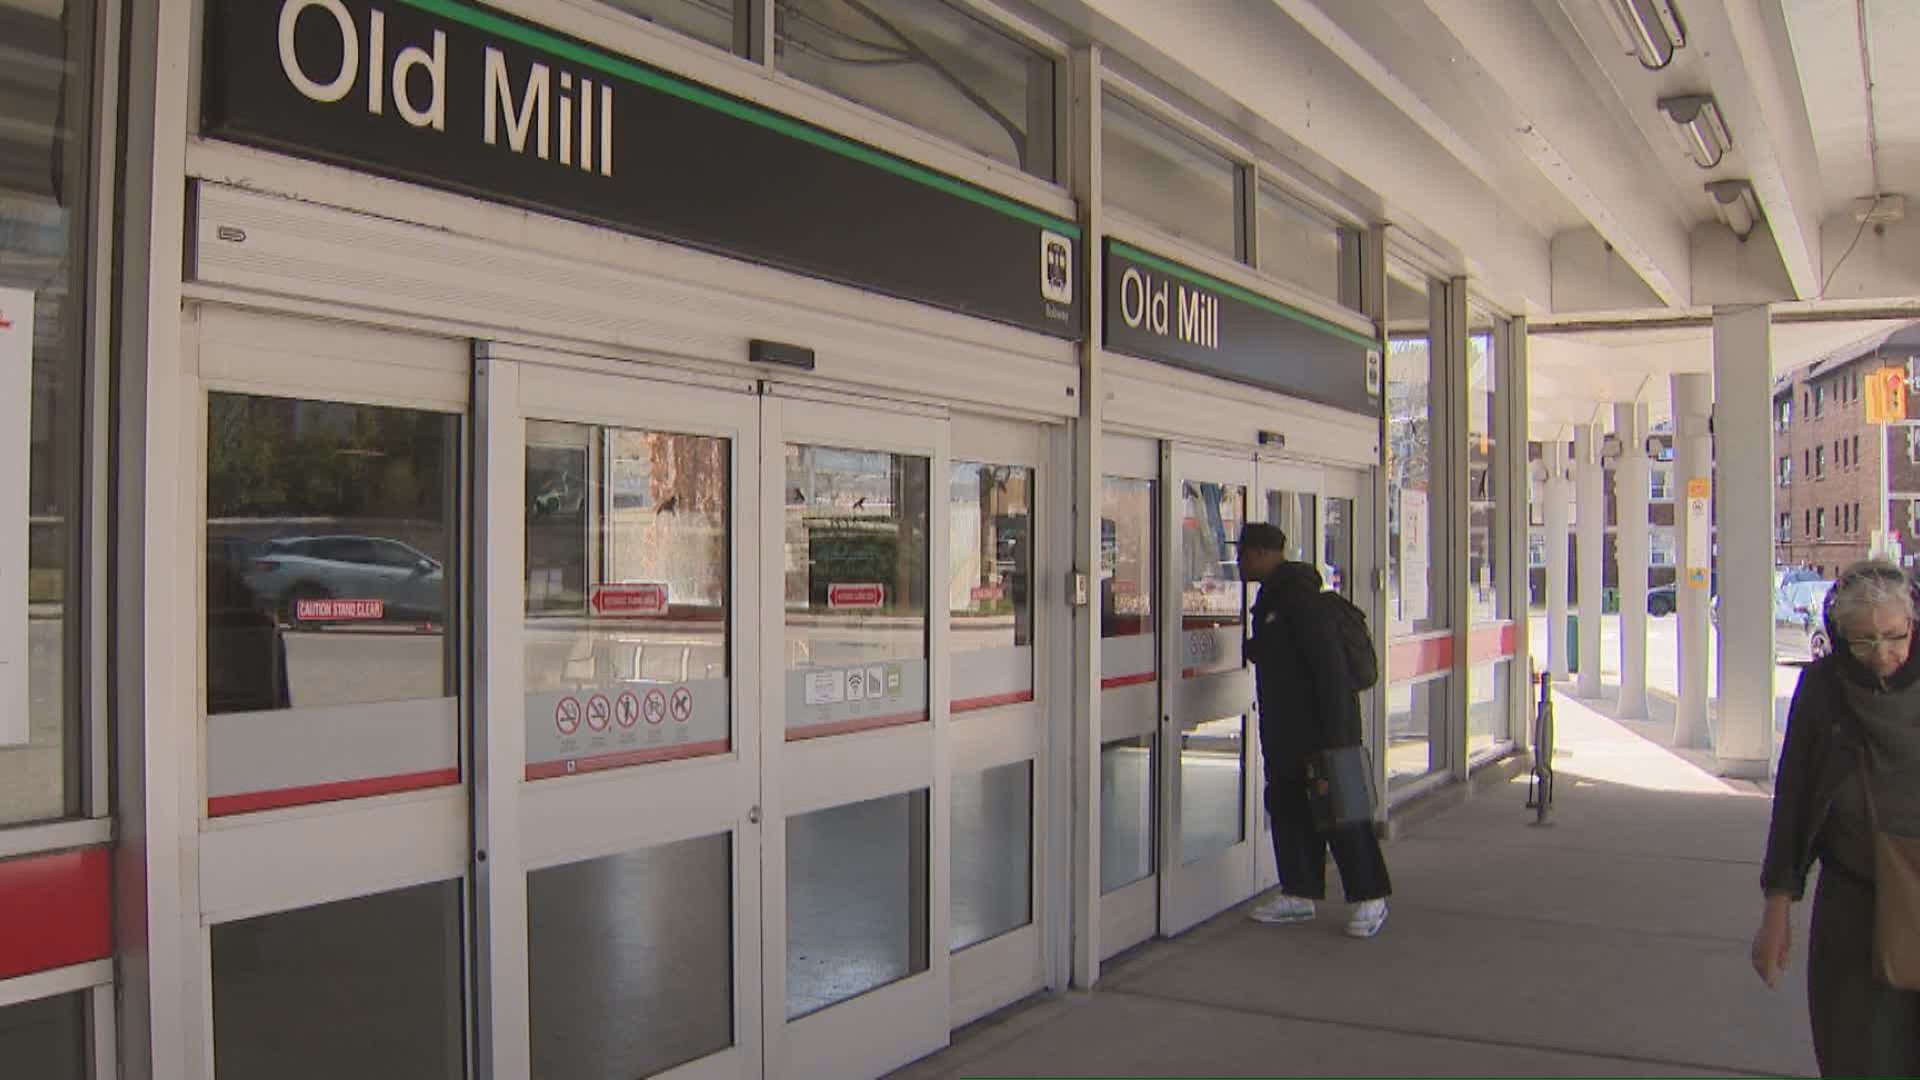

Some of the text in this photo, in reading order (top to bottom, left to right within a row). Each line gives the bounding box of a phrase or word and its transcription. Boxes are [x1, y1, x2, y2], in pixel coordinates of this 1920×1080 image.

[278, 0, 612, 177] Old Mill
[1121, 268, 1218, 349] Old Mill
[300, 601, 380, 617] CAUTION STAND CLEAR
